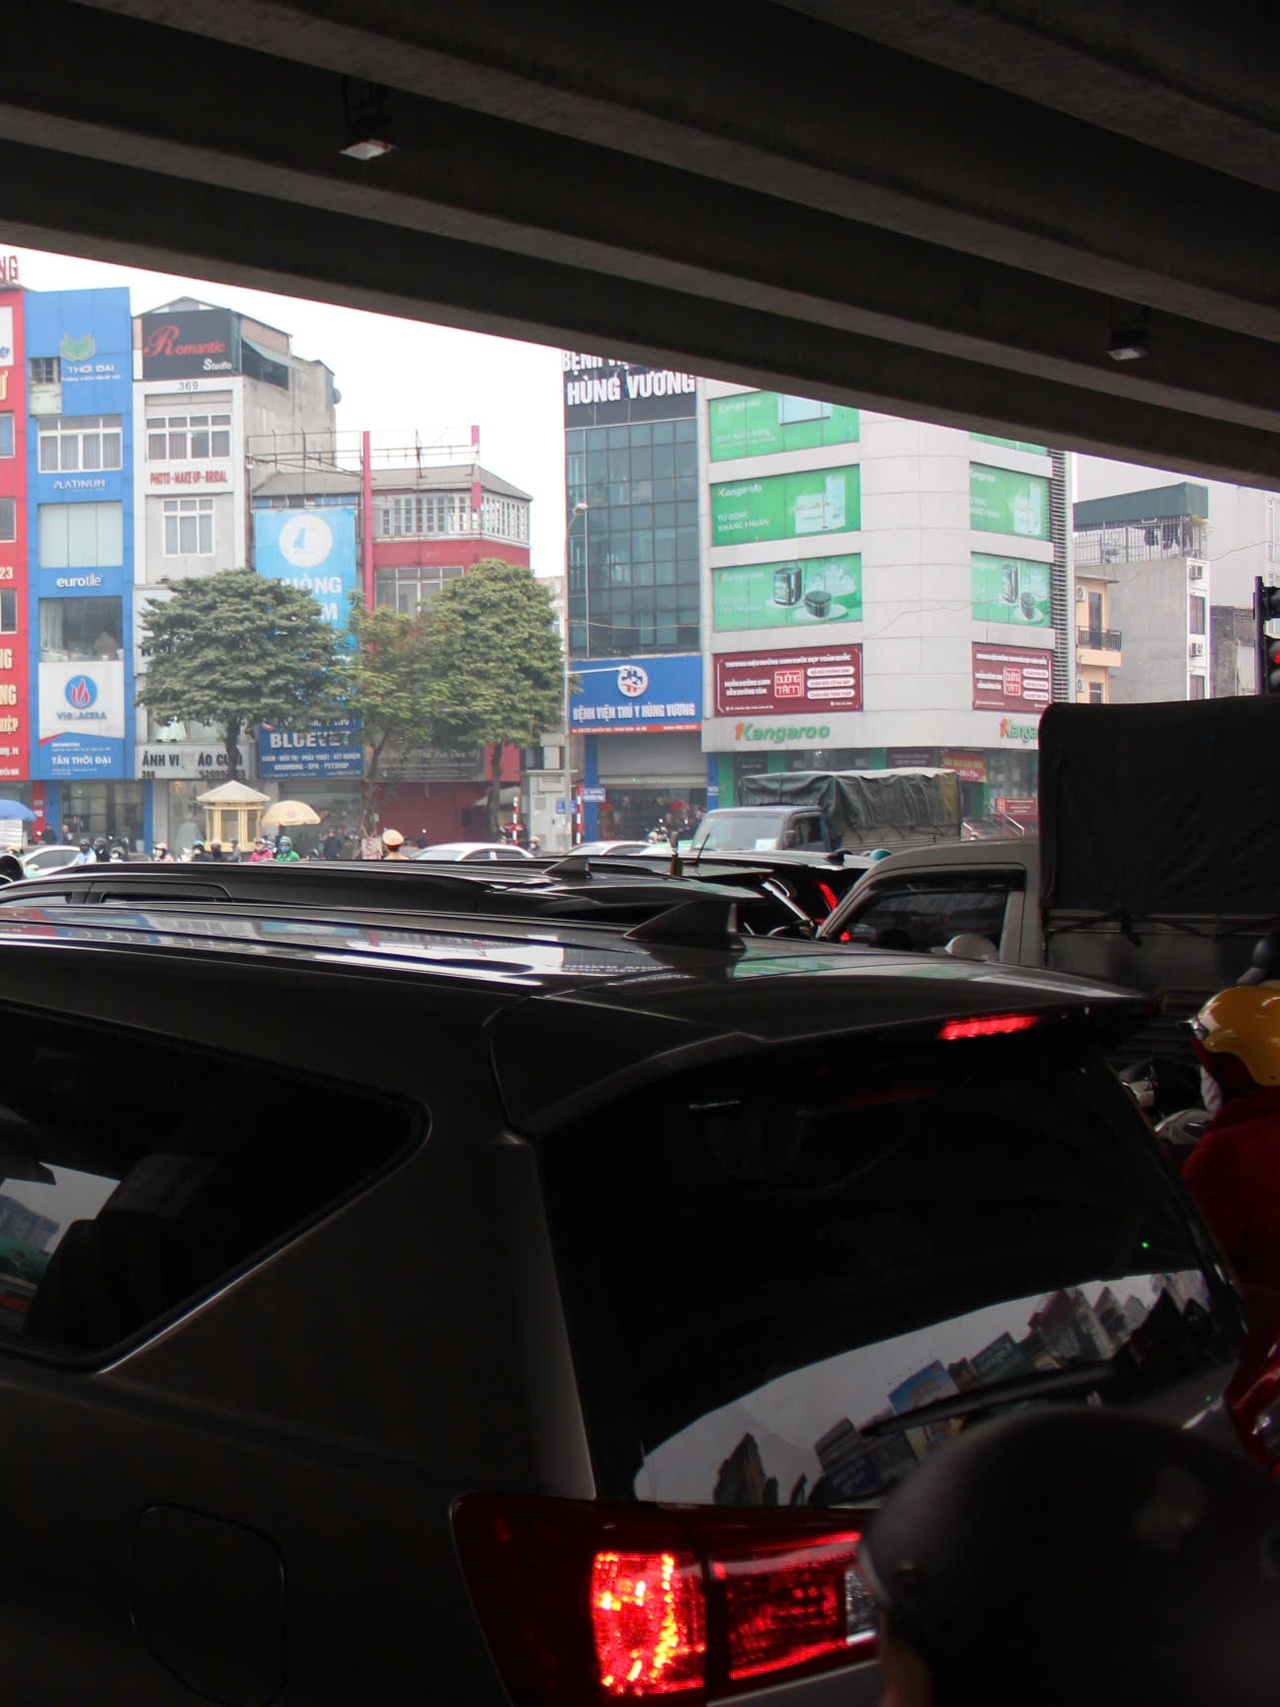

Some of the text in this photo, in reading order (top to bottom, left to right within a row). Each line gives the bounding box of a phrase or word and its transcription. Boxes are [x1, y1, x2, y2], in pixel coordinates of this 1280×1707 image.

[143, 325, 226, 357] Romantic
[202, 359, 233, 371] Studio
[178, 382, 199, 391] 369
[567, 370, 695, 406] HÙNG VƯƠNG
[56, 574, 102, 587] eurotile
[634, 706, 641, 718] Y
[735, 722, 830, 744] Kangaroo
[1000, 718, 1039, 743] Kanga
[51, 756, 69, 765] TÂN
[197, 753, 213, 766] ÁO
